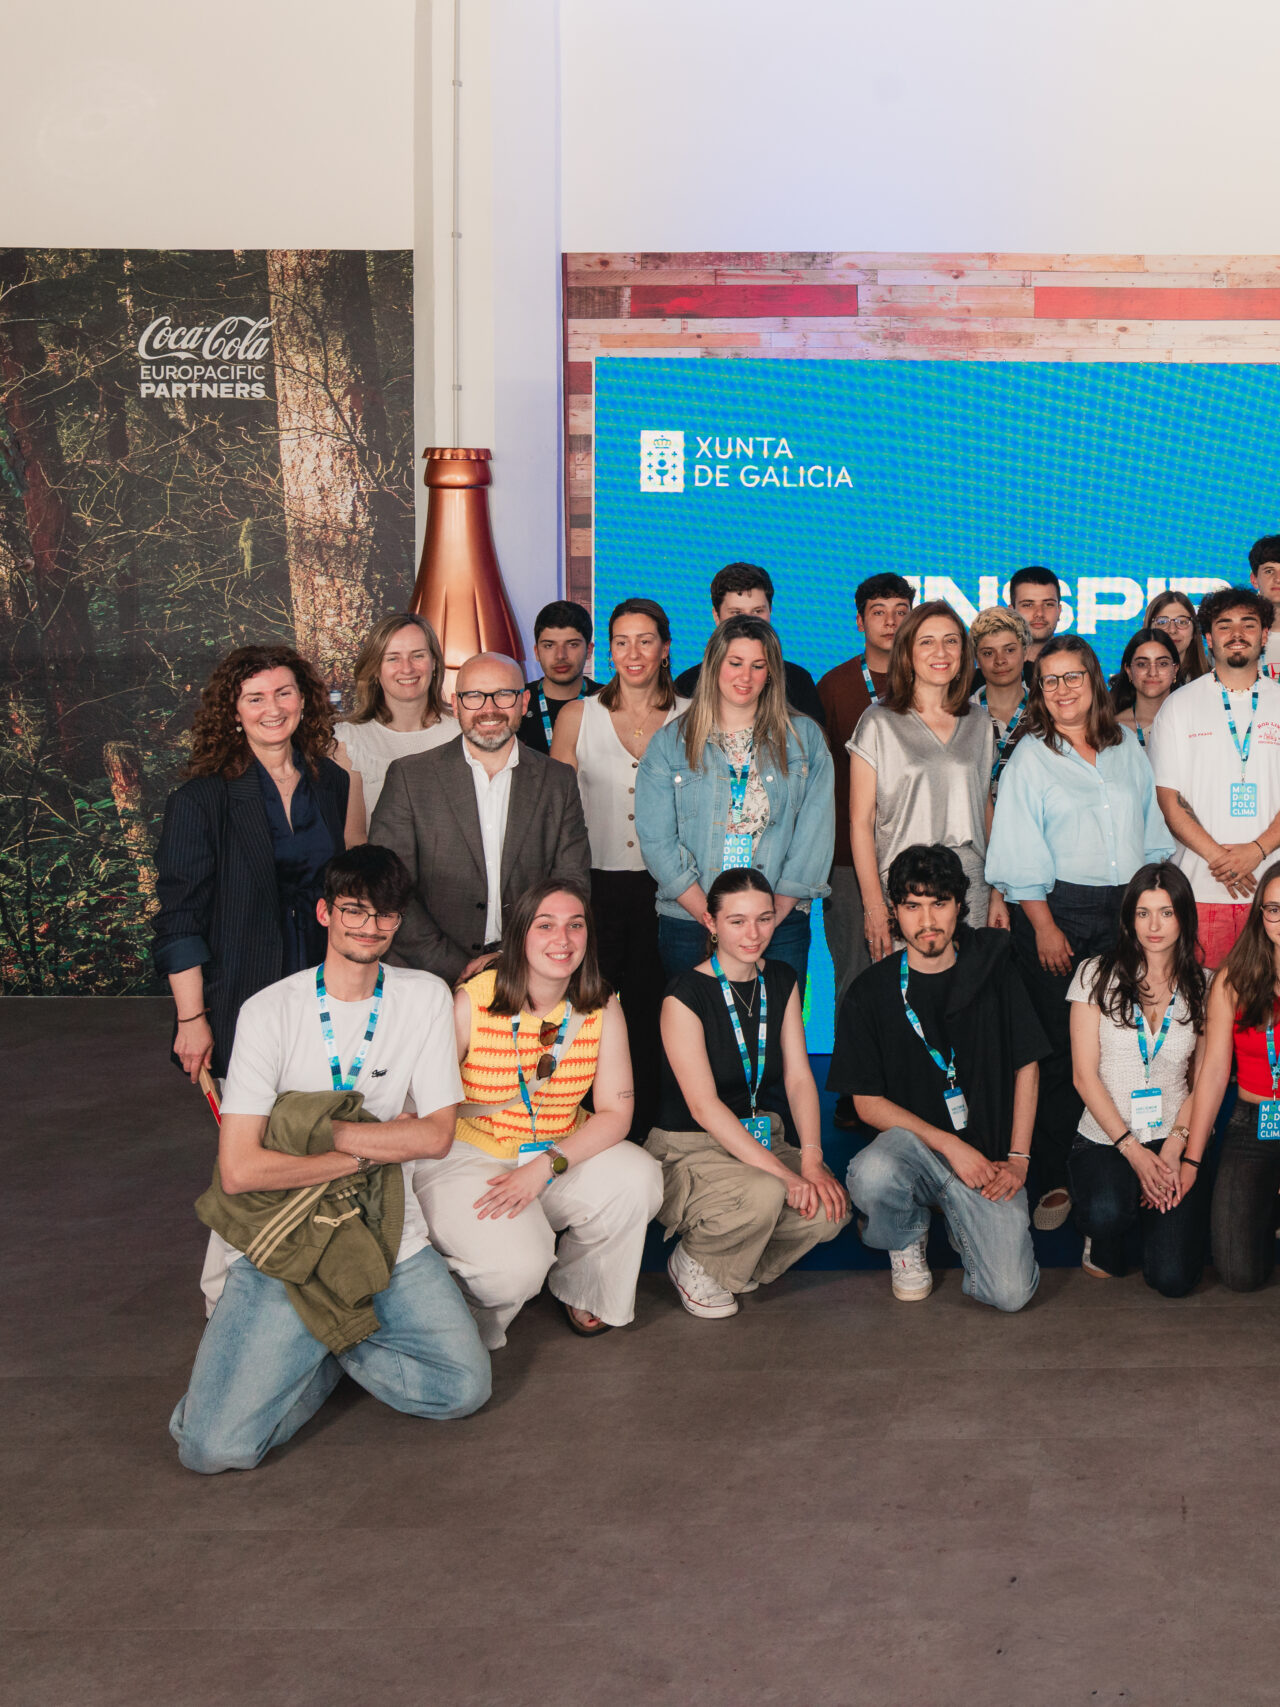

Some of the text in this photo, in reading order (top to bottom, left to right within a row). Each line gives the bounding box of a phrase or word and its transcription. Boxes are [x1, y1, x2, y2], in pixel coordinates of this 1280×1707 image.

[138, 315, 278, 361] Coca-Cola
[140, 365, 266, 380] EUROPACIFIC
[140, 382, 266, 399] PARTNERS
[695, 436, 794, 459] XUNTA
[694, 464, 854, 488] DE GALICIA
[1232, 808, 1255, 816] CLIMA
[723, 855, 750, 863] POLO
